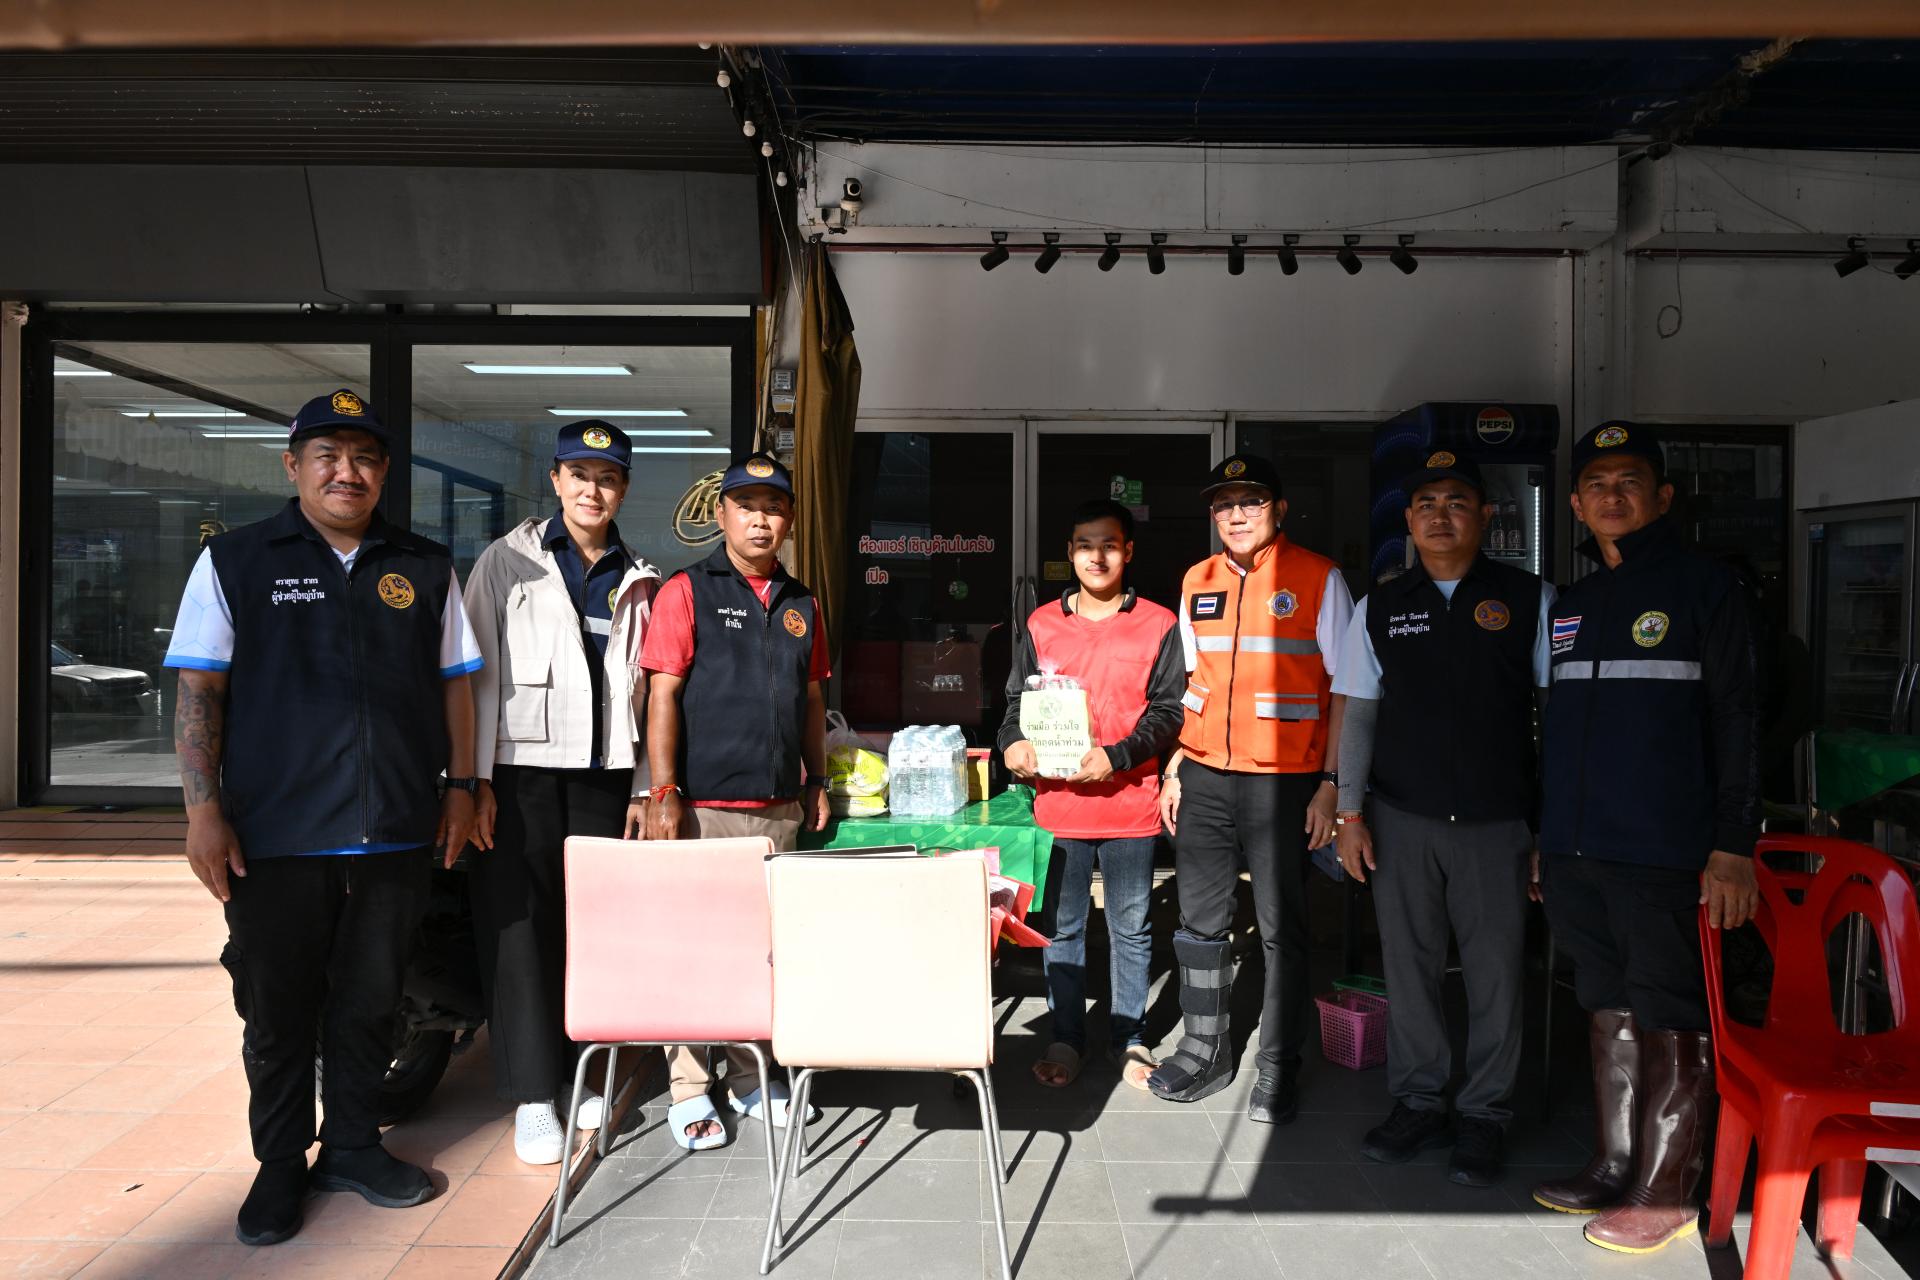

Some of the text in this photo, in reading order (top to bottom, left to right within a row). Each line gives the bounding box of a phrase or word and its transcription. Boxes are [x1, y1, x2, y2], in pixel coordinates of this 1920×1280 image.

[1479, 420, 1513, 429] PEPSI
[859, 534, 995, 556] ห้องแอร์ เชิญด้านในครับ
[865, 565, 889, 584] เปิด
[271, 588, 325, 605] ผู้ช่วยผู้ใหญ่บ้าน
[725, 617, 742, 629] กำนัน
[1388, 623, 1430, 638] ผู้ช่วยผู้ใหญ่บ้าน
[1026, 719, 1080, 731] ร่วมมือ ร่วมใจ
